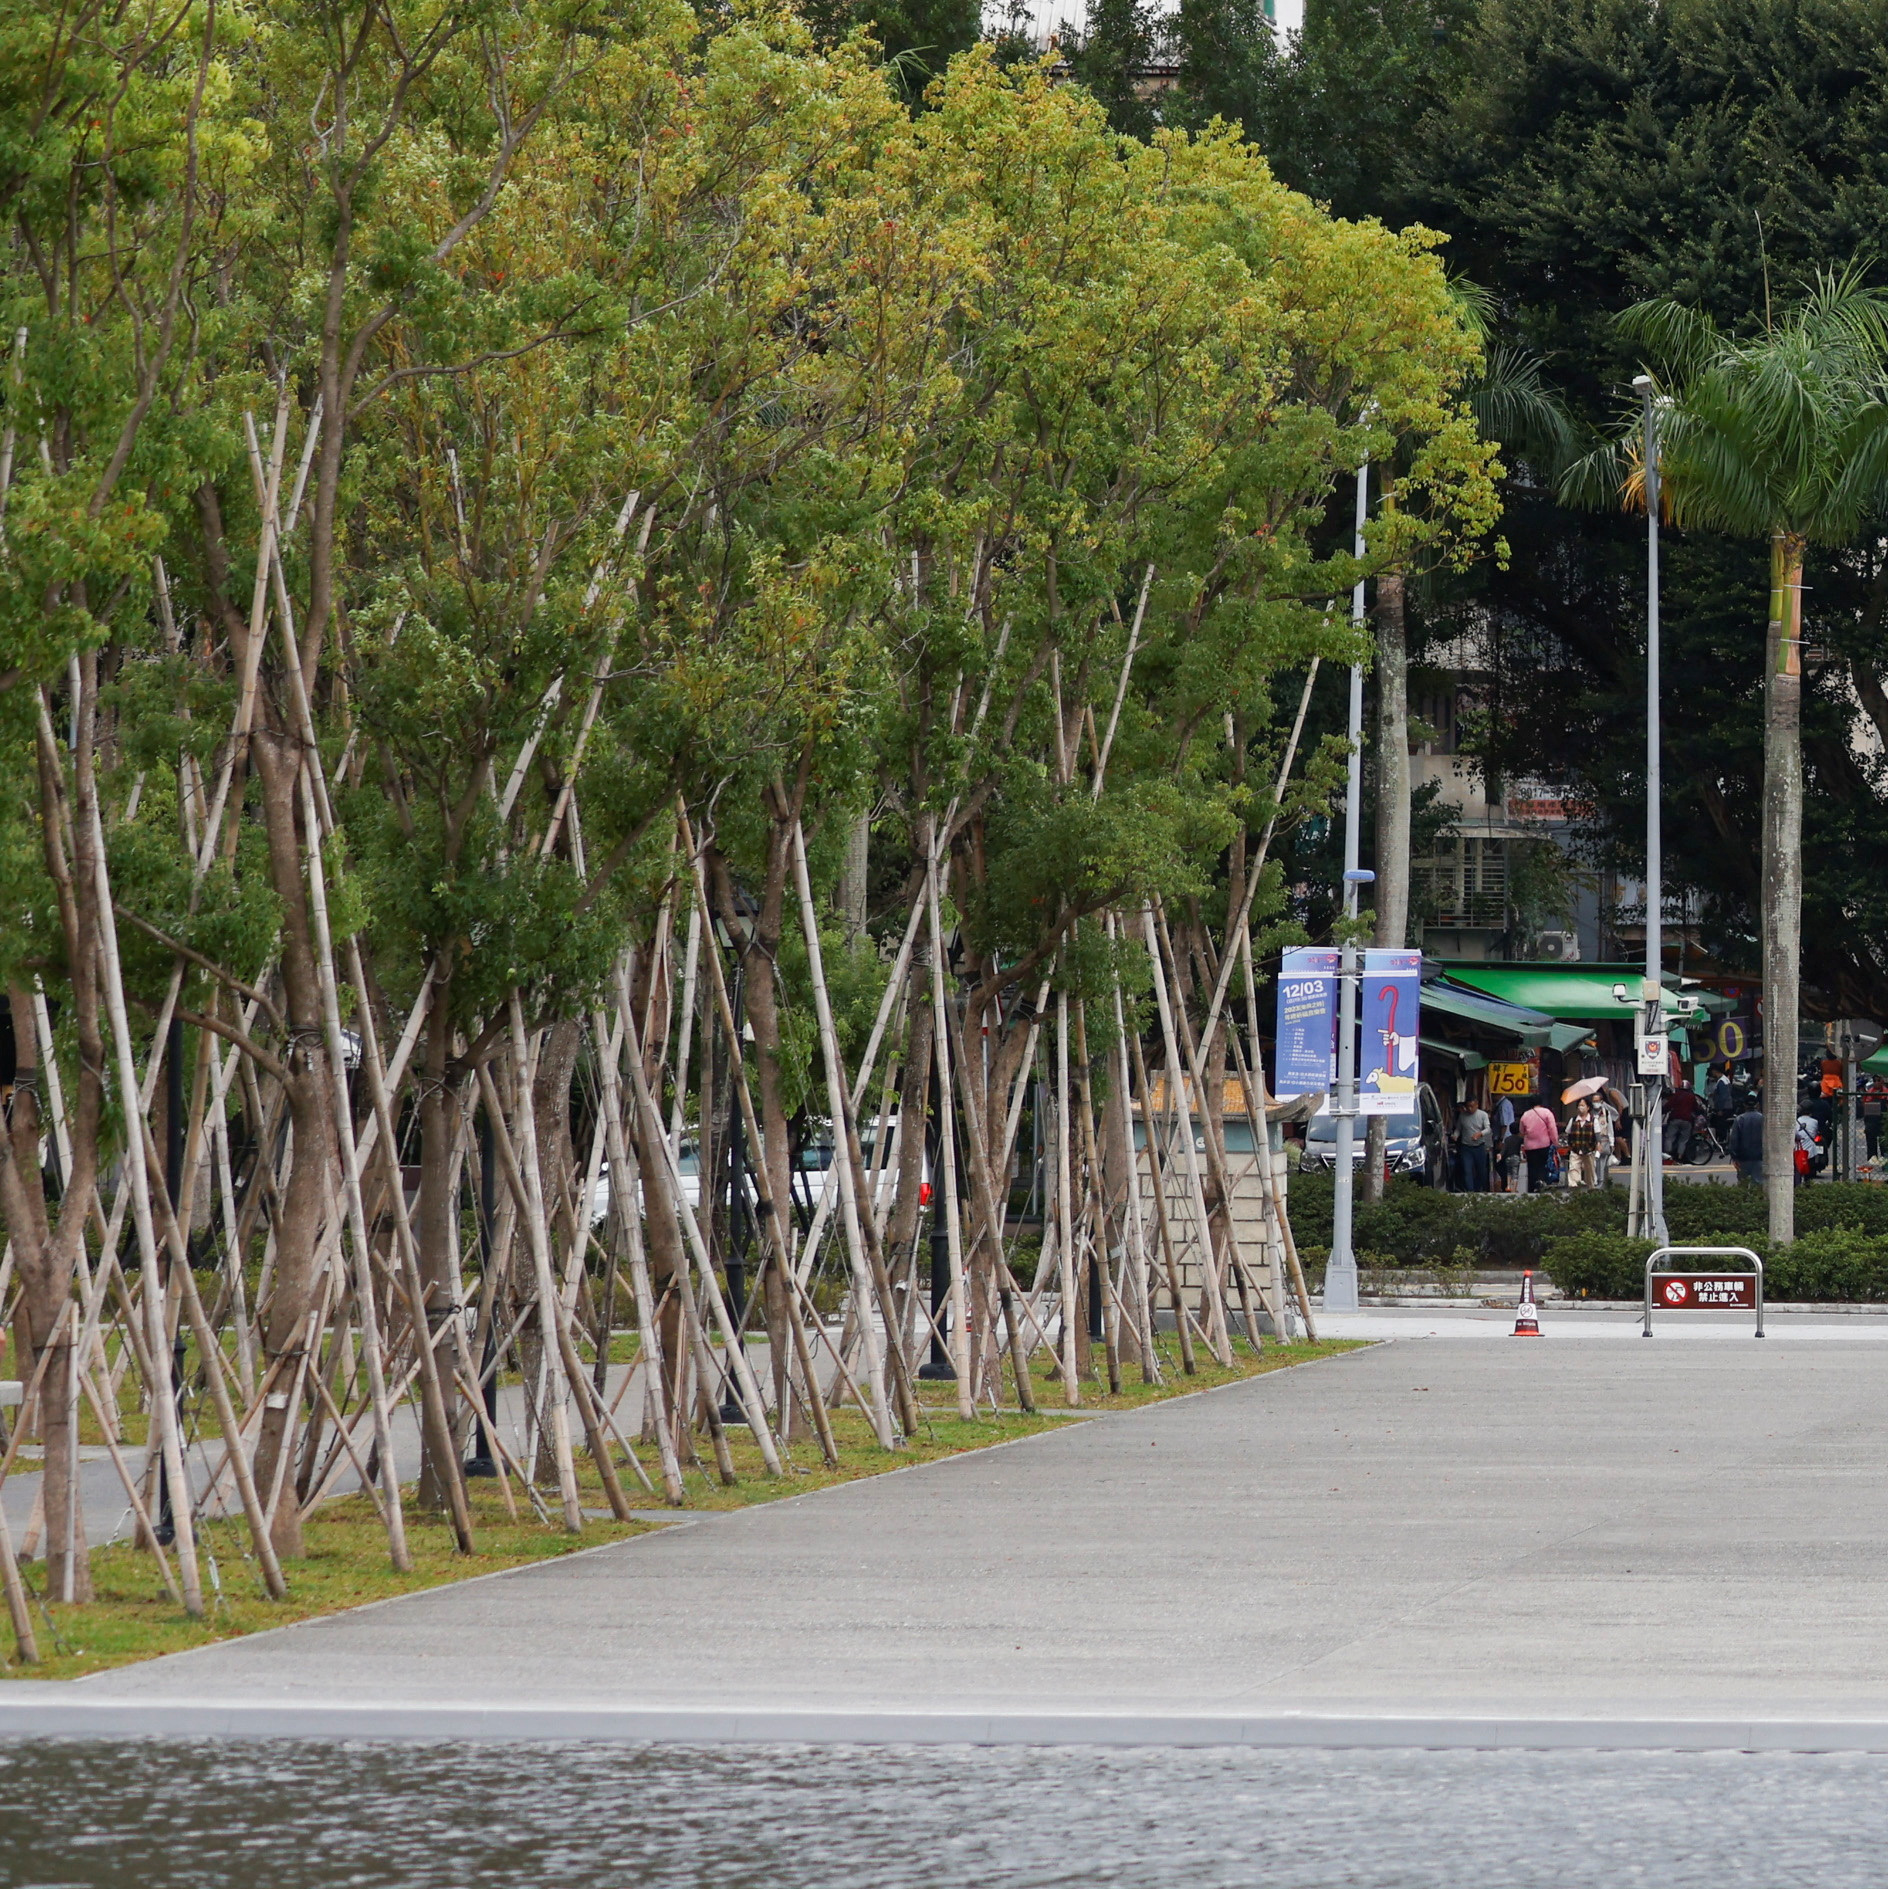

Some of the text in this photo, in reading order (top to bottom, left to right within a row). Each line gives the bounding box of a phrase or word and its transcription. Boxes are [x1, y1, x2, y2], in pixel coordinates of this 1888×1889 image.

[1283, 980, 1324, 998] 12/03
[1493, 1073, 1526, 1092] 150
[1693, 1281, 1744, 1292] 非公務車輛
[1698, 1292, 1739, 1303] 禁止進入
